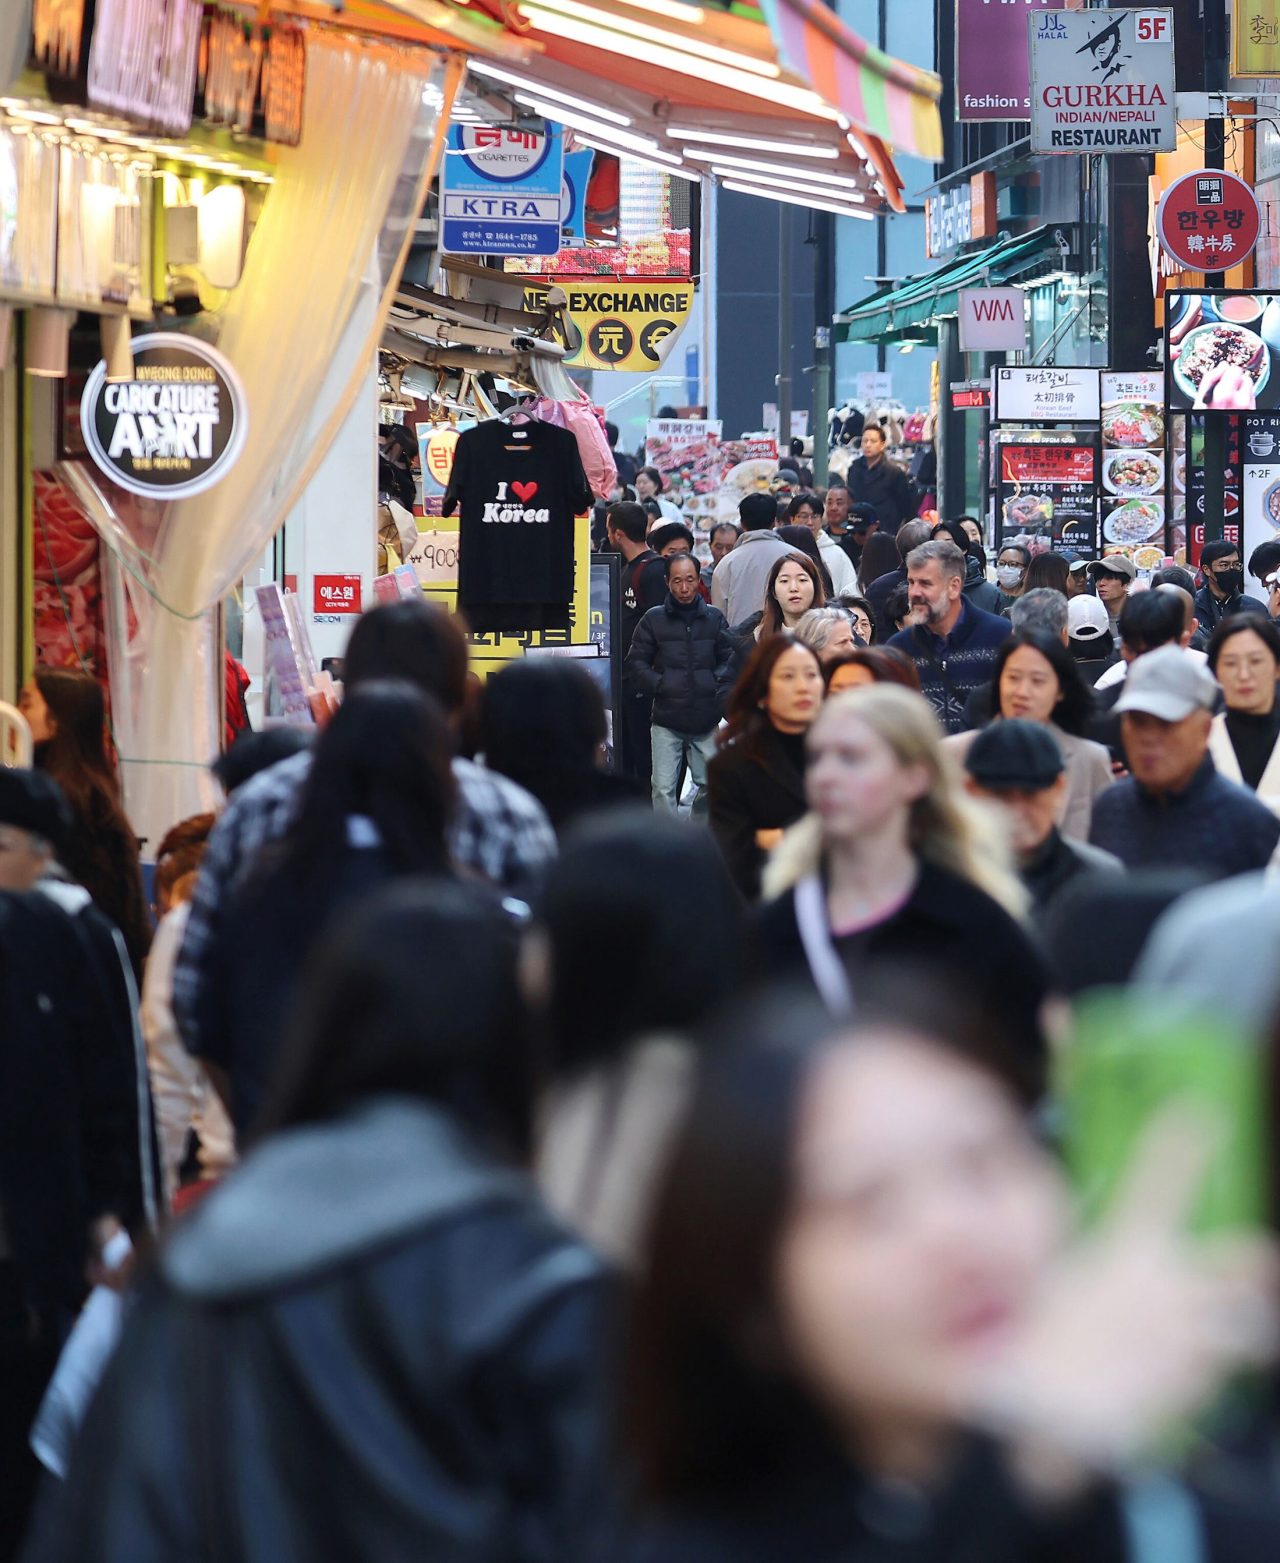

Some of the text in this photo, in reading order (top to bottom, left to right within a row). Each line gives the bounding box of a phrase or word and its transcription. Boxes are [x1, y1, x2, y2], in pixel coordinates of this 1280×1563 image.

[1039, 14, 1067, 31] حلال
[1138, 17, 1167, 40] 5F
[1038, 32, 1068, 40] HALAL
[965, 94, 1031, 108] fashion s
[1042, 83, 1167, 108] GURKHA
[1055, 110, 1155, 124] INDIAN/NEPALI
[1051, 128, 1162, 146] RESTAURANT
[476, 152, 530, 163] CIGARETTES
[462, 198, 541, 217] KTRA
[1177, 209, 1245, 230] 한우방
[1187, 234, 1236, 253] 韓牛房
[1205, 255, 1219, 266] 3F
[569, 293, 688, 312] EXCHANGE
[972, 299, 1014, 321] WM
[136, 367, 215, 382] MYEONG DONG
[1002, 371, 1010, 379] 6
[105, 385, 219, 414] CARICATURE
[1258, 469, 1271, 478] 2F
[495, 482, 507, 500] I
[482, 503, 550, 523] Korea
[320, 586, 354, 600] 에스원
[313, 615, 341, 623] SECOM
